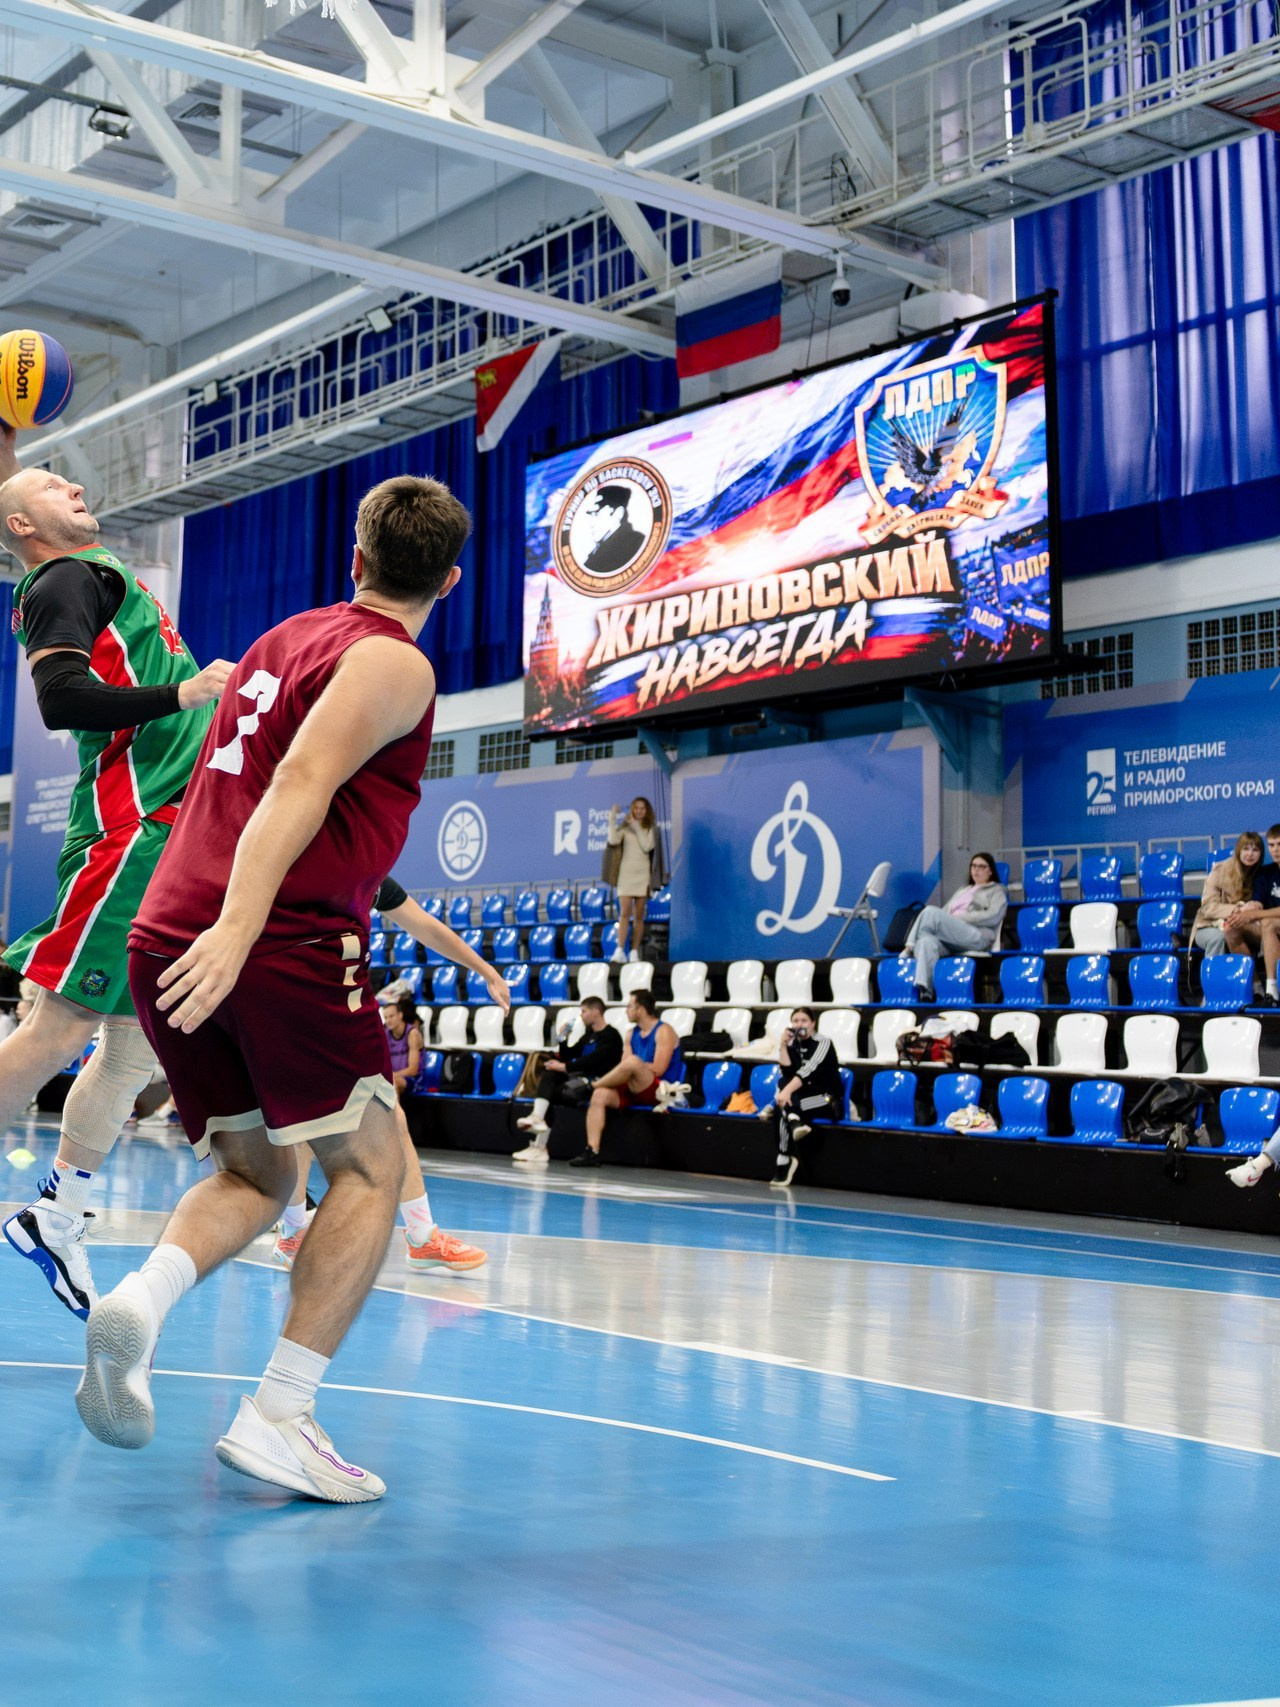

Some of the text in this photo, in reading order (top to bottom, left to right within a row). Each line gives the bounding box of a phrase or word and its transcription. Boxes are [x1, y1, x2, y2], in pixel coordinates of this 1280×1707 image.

[17, 337, 36, 403] Wilson
[882, 362, 977, 421] ЛДПР
[1001, 551, 1050, 587] ЛДПР
[585, 531, 955, 671] ЖИРИНОВСКИЙ
[635, 599, 873, 712] НАВСЕГДА
[1123, 741, 1227, 767] ТЕЛЕВИДЕНИЕ
[1124, 766, 1186, 787] И РАДИО
[1124, 778, 1275, 808] ПРИМОРСКОГО КРАЯ
[1086, 803, 1117, 817] РЕГИОН
